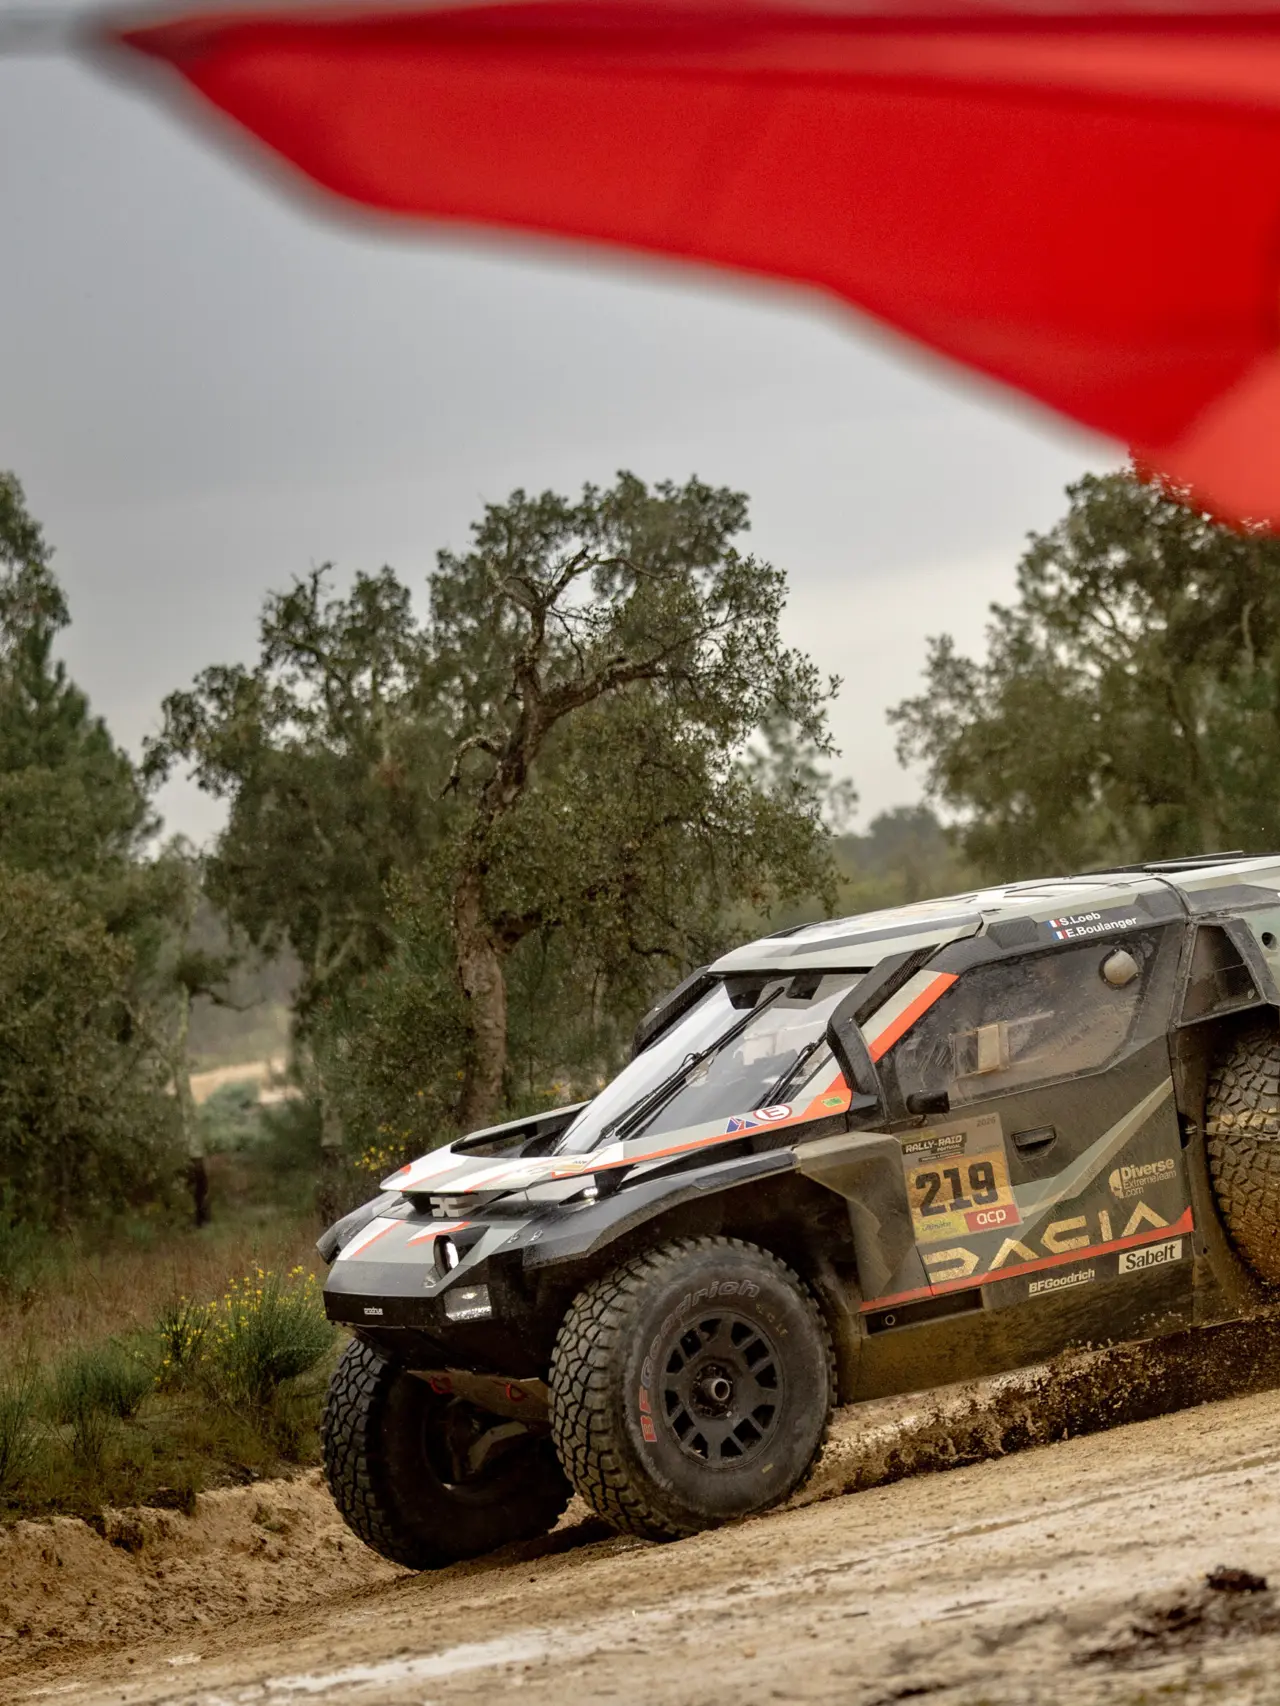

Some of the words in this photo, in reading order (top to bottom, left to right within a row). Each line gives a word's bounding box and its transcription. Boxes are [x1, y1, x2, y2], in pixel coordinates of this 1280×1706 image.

[1059, 912, 1101, 926] S.Loeb
[1066, 917, 1137, 938] E.Boulanger
[1120, 1158, 1175, 1180] Diverse
[1123, 1170, 1177, 1189] ExtremeTeam
[915, 1161, 999, 1217] 219
[1124, 1187, 1144, 1198] .com
[976, 1209, 1007, 1225] acp
[922, 1201, 1169, 1284] DACIA
[1124, 1244, 1176, 1272] Sabelt
[1029, 1268, 1096, 1294] BFGoodrich
